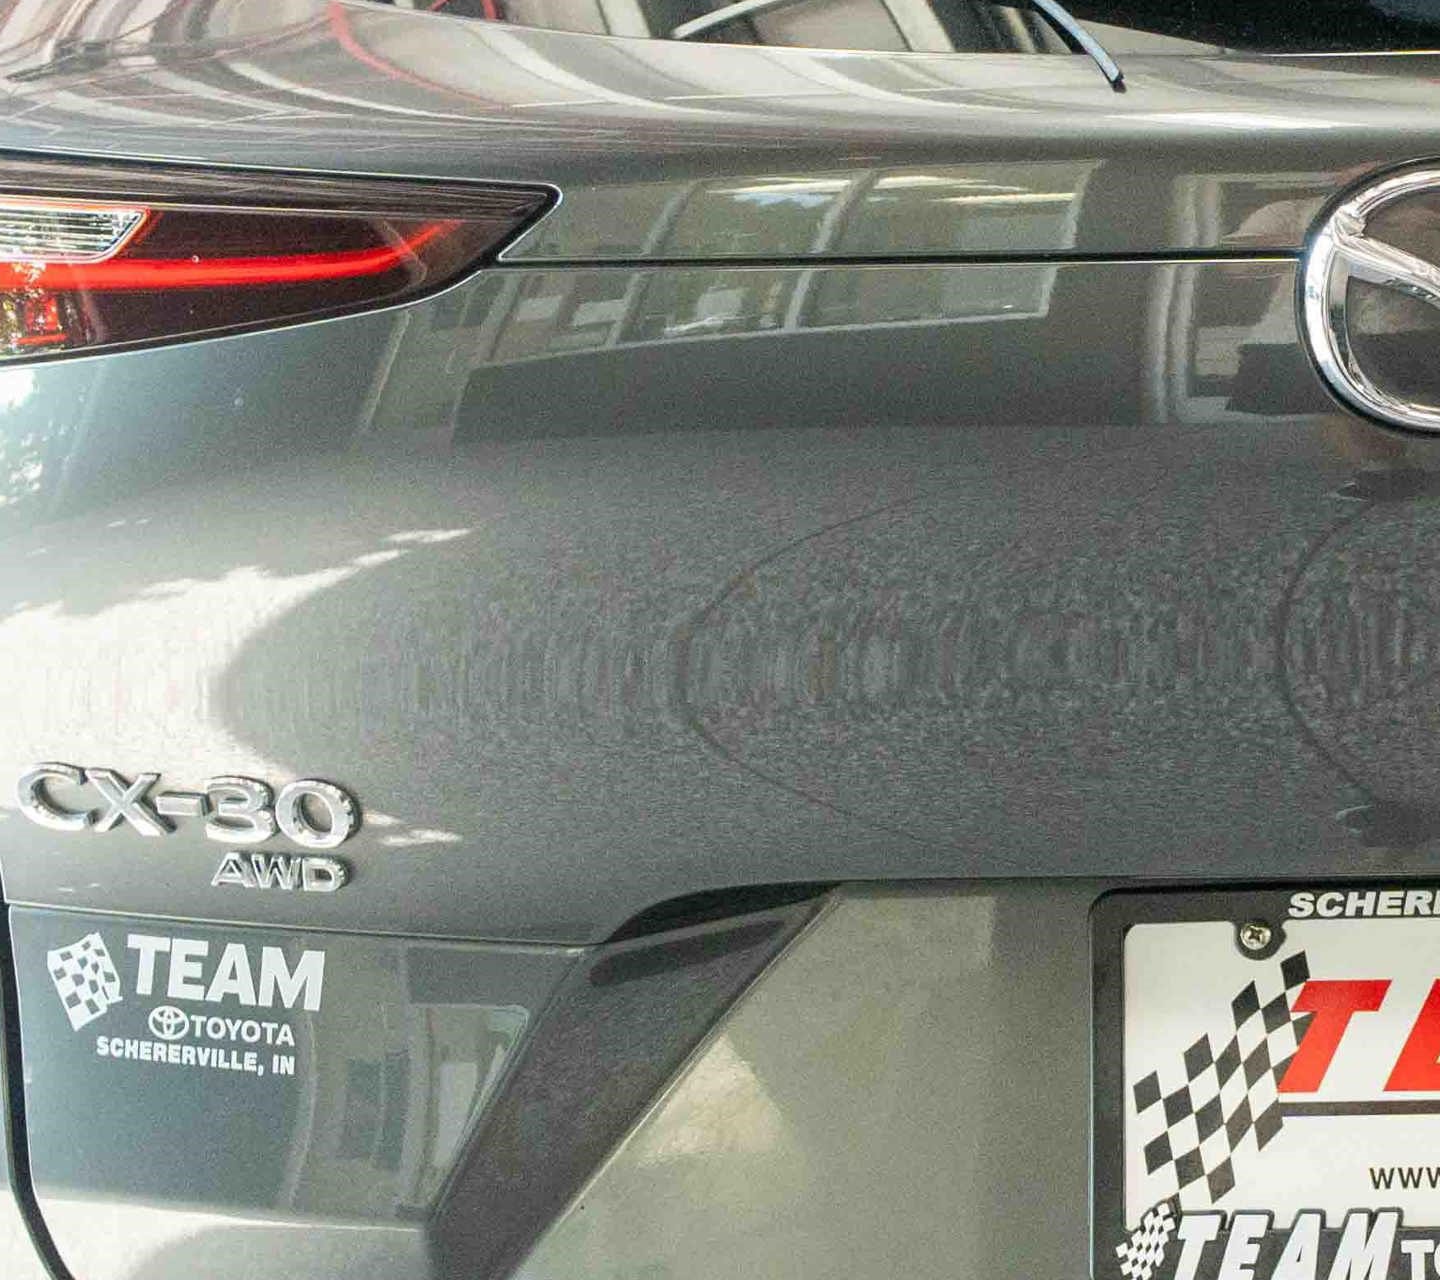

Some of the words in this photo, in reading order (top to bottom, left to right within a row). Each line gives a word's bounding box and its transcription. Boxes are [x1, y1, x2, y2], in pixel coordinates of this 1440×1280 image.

[17, 761, 361, 849] CX-30
[210, 851, 350, 893] AWD
[127, 934, 326, 1012] TEAM
[191, 1015, 296, 1047] TOYOTA
[96, 1036, 265, 1077] SCHERERVILLE,
[272, 1055, 296, 1076] IN
